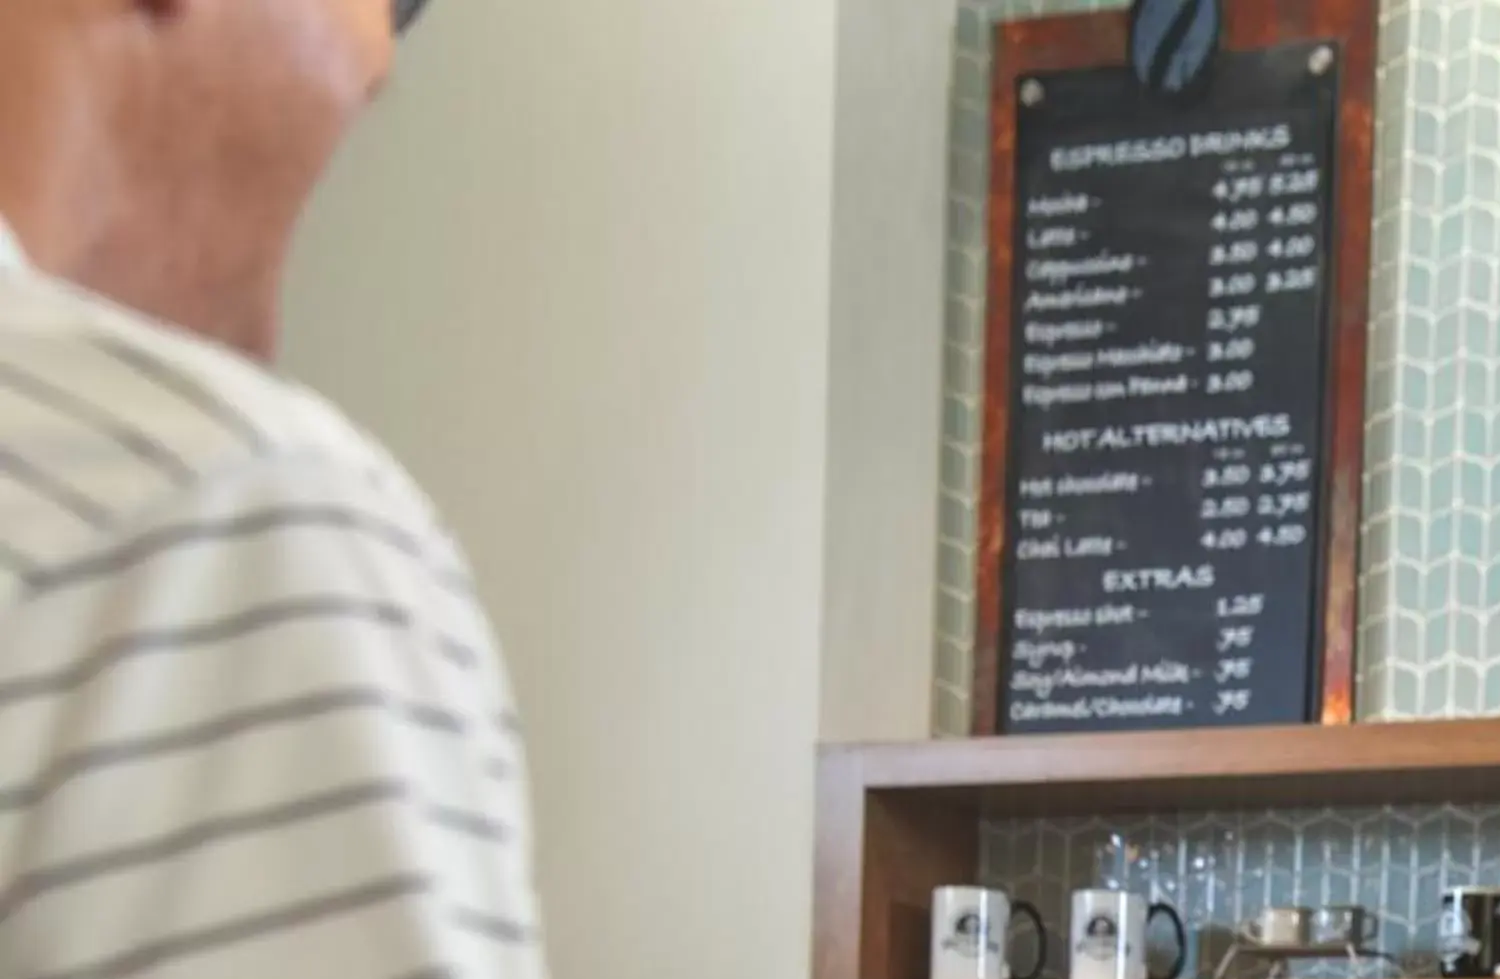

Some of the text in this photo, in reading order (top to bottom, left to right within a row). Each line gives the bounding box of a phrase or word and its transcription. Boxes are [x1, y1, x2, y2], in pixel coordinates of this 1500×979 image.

[1050, 136, 1187, 172] ESPRESSO
[1190, 123, 1291, 157] DRINKS
[1043, 412, 1292, 453] HOT ALTERNATIVES
[1102, 564, 1216, 593] EXTRAS
